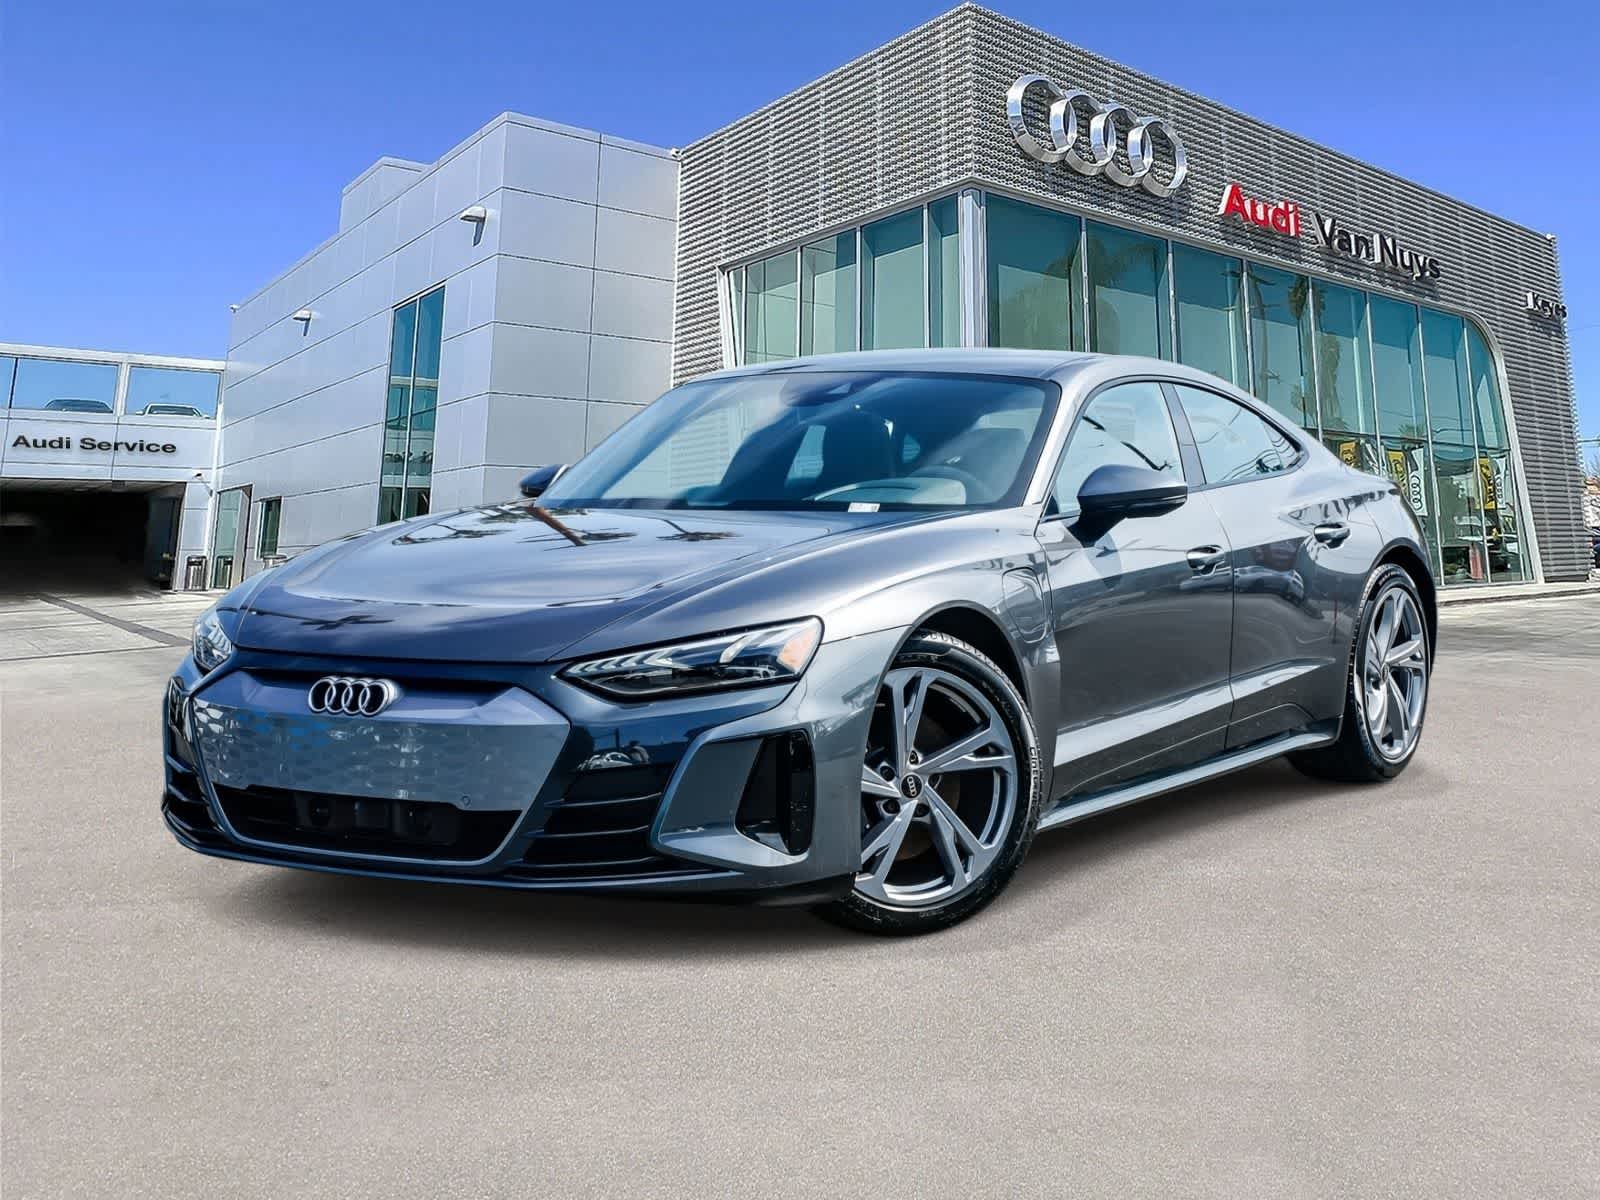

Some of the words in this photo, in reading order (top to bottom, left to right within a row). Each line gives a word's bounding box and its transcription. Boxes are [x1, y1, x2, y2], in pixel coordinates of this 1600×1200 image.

[1217, 182, 1302, 237] Audi
[1311, 211, 1371, 260] Van
[1372, 232, 1442, 281] Nuys
[12, 434, 72, 450] Audi
[79, 437, 178, 454] Service
